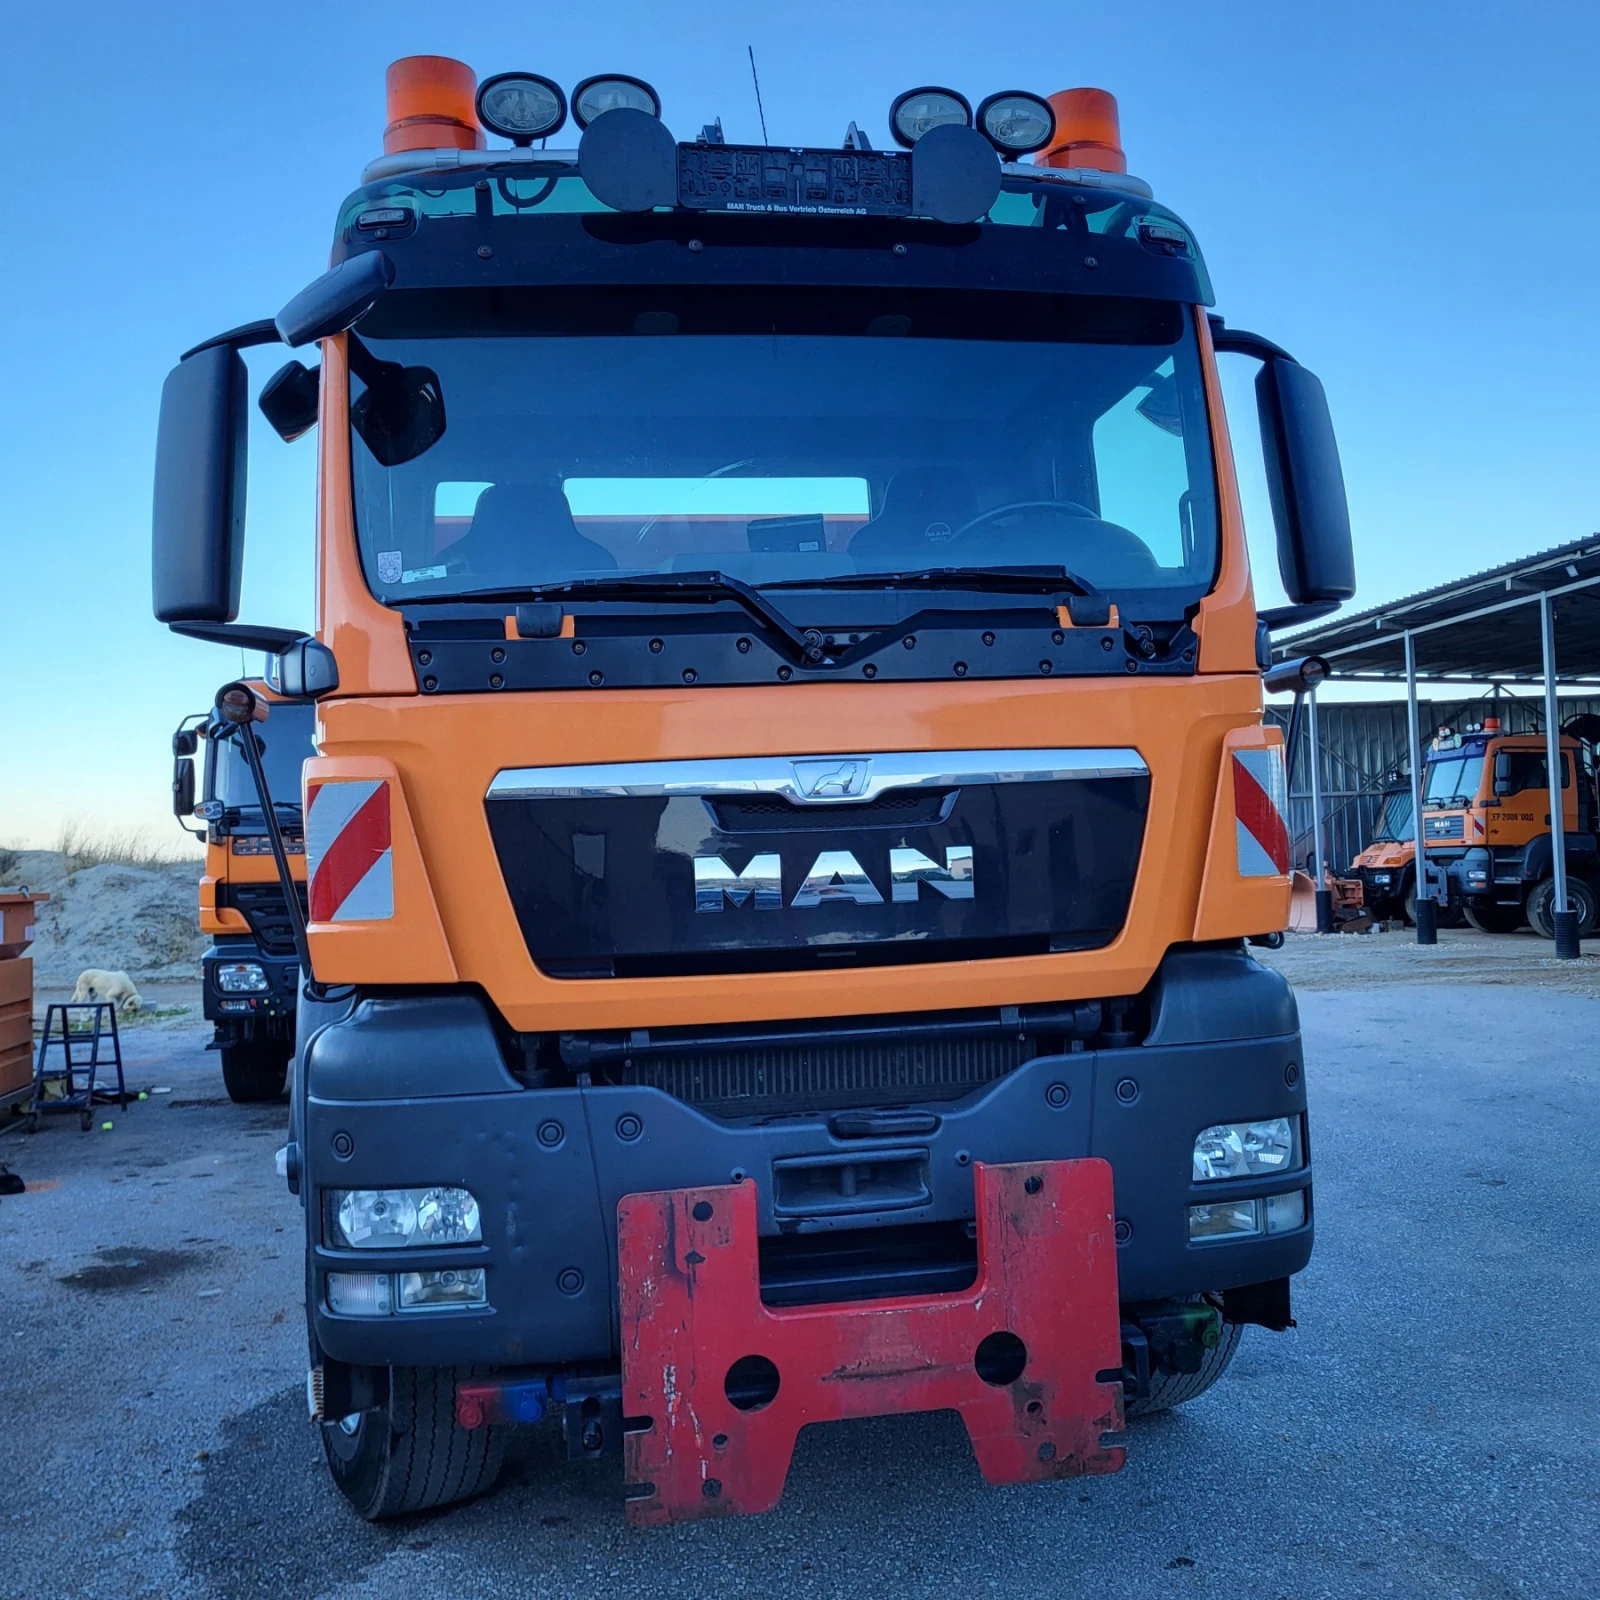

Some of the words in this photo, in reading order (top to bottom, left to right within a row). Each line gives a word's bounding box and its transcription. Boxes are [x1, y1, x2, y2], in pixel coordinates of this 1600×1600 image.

[727, 202, 744, 210] MAN
[746, 203, 766, 211] Truck
[767, 204, 773, 212] &
[774, 204, 788, 212] Bus
[789, 205, 817, 213] Vertrieb
[818, 205, 854, 215] Österreich
[693, 846, 975, 913] MAN
